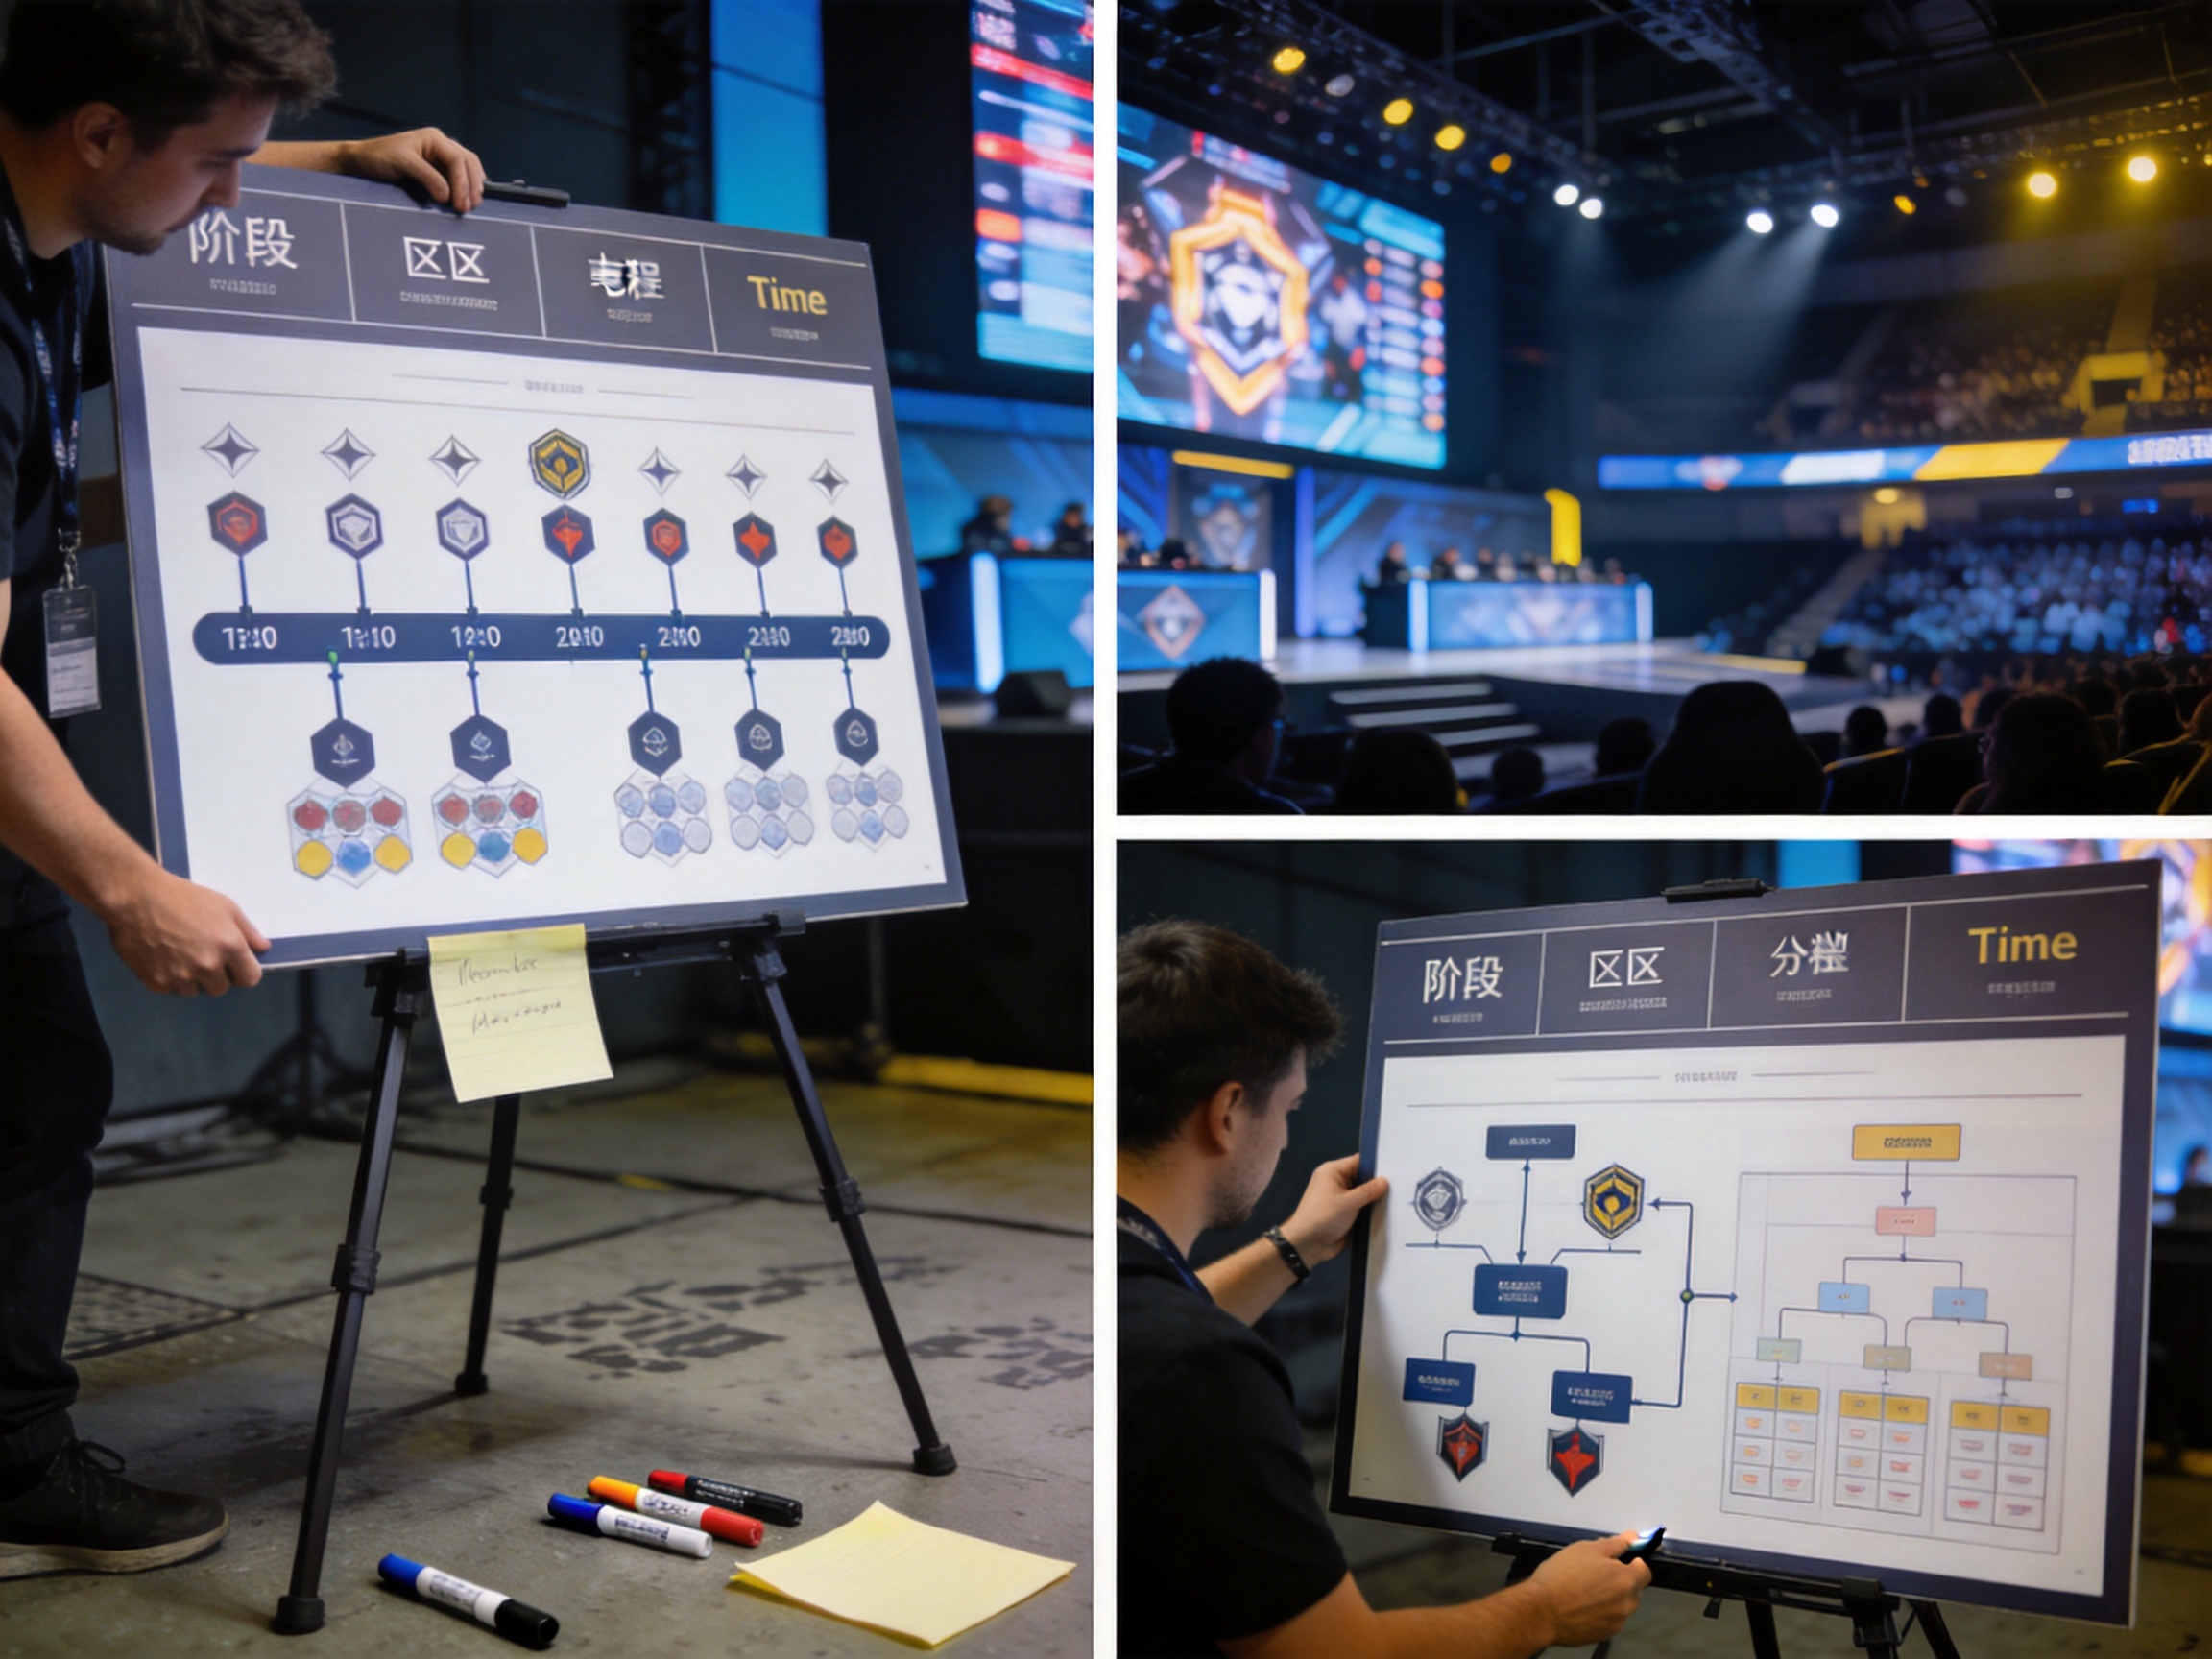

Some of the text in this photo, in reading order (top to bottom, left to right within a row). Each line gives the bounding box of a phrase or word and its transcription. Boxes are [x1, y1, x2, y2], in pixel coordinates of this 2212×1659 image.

[188, 210, 299, 270] 阶段
[747, 275, 829, 316] Time
[1968, 925, 2079, 964] Time
[1423, 956, 1504, 1004] 阶段
